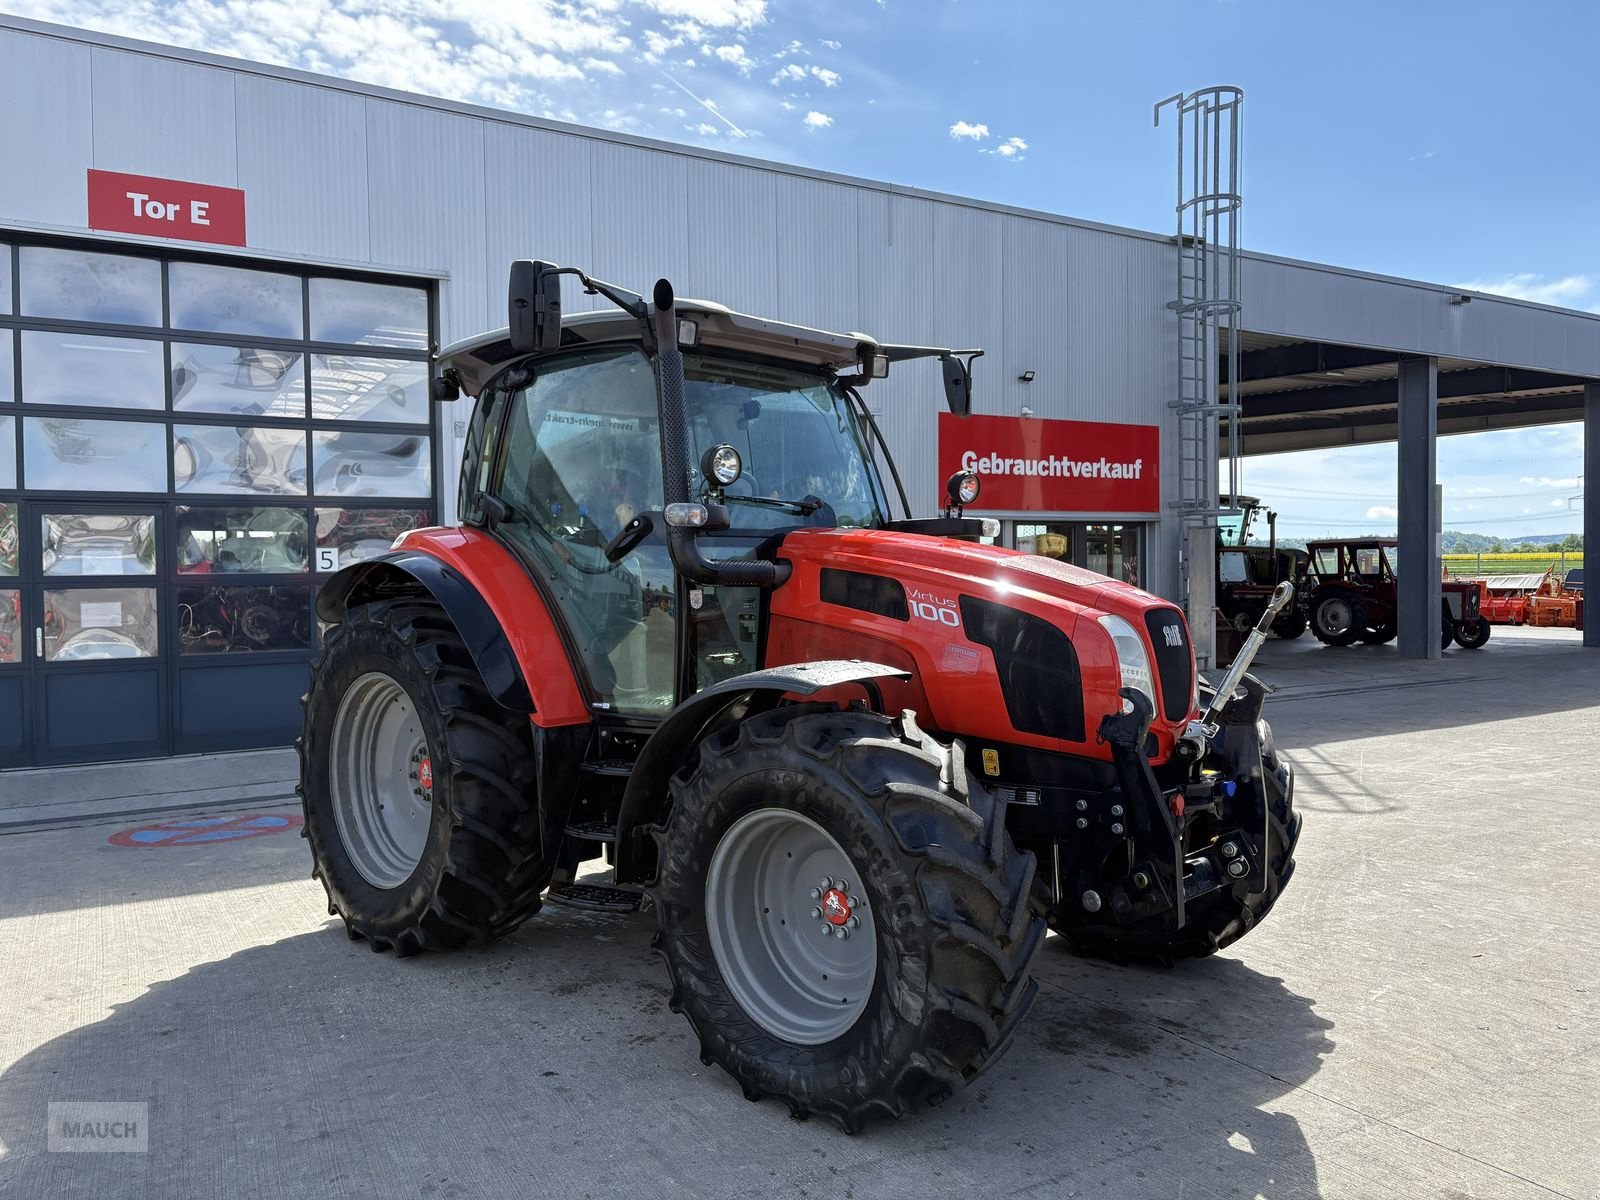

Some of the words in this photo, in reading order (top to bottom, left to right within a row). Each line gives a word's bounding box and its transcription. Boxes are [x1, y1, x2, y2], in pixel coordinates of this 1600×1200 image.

[126, 192, 180, 221] Tor
[190, 200, 210, 225] E
[961, 450, 1142, 480] Gebrauchtverkauf
[320, 551, 333, 570] 5
[905, 587, 957, 608] Virtus
[909, 599, 960, 627] 100
